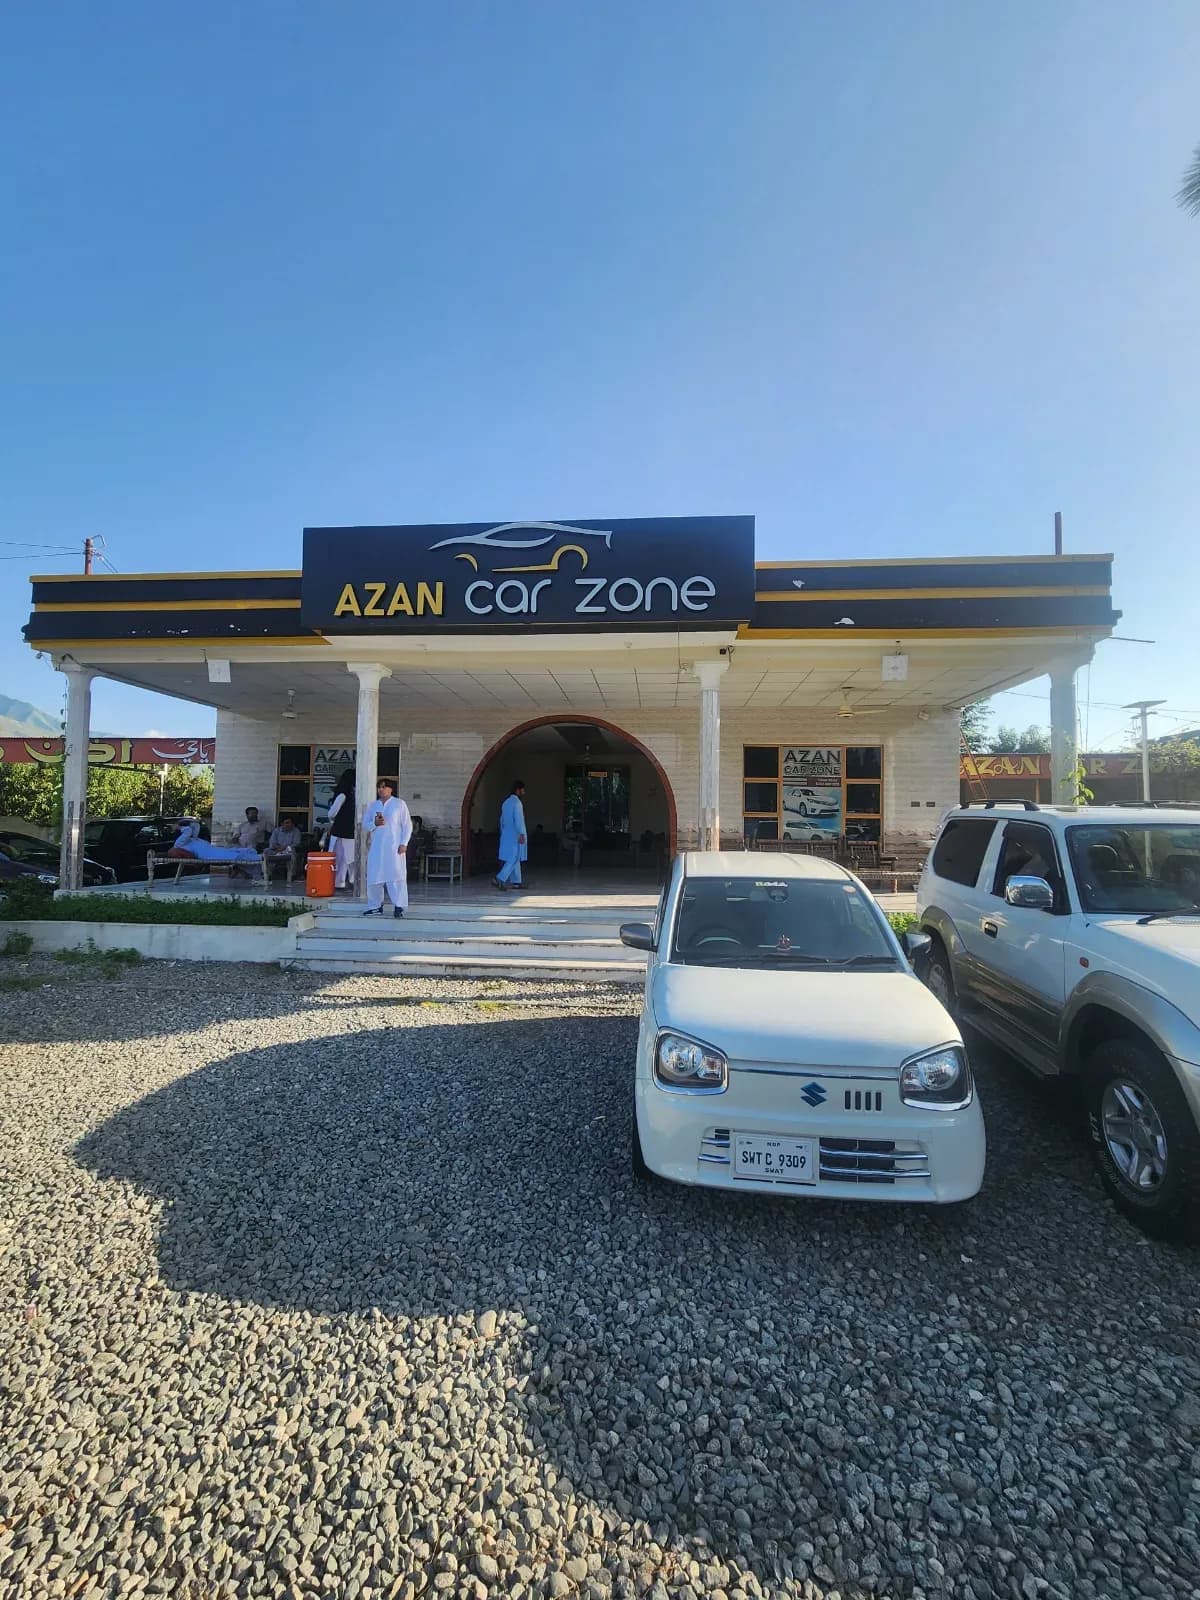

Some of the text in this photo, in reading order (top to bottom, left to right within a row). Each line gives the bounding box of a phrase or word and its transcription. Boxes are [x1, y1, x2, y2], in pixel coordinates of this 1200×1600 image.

[334, 576, 716, 616] AZAN car zone
[784, 750, 840, 762] AZAN
[810, 766, 840, 775] ZONE
[959, 756, 1041, 776] AZAN
[742, 1151, 806, 1168] SWT C 9309
